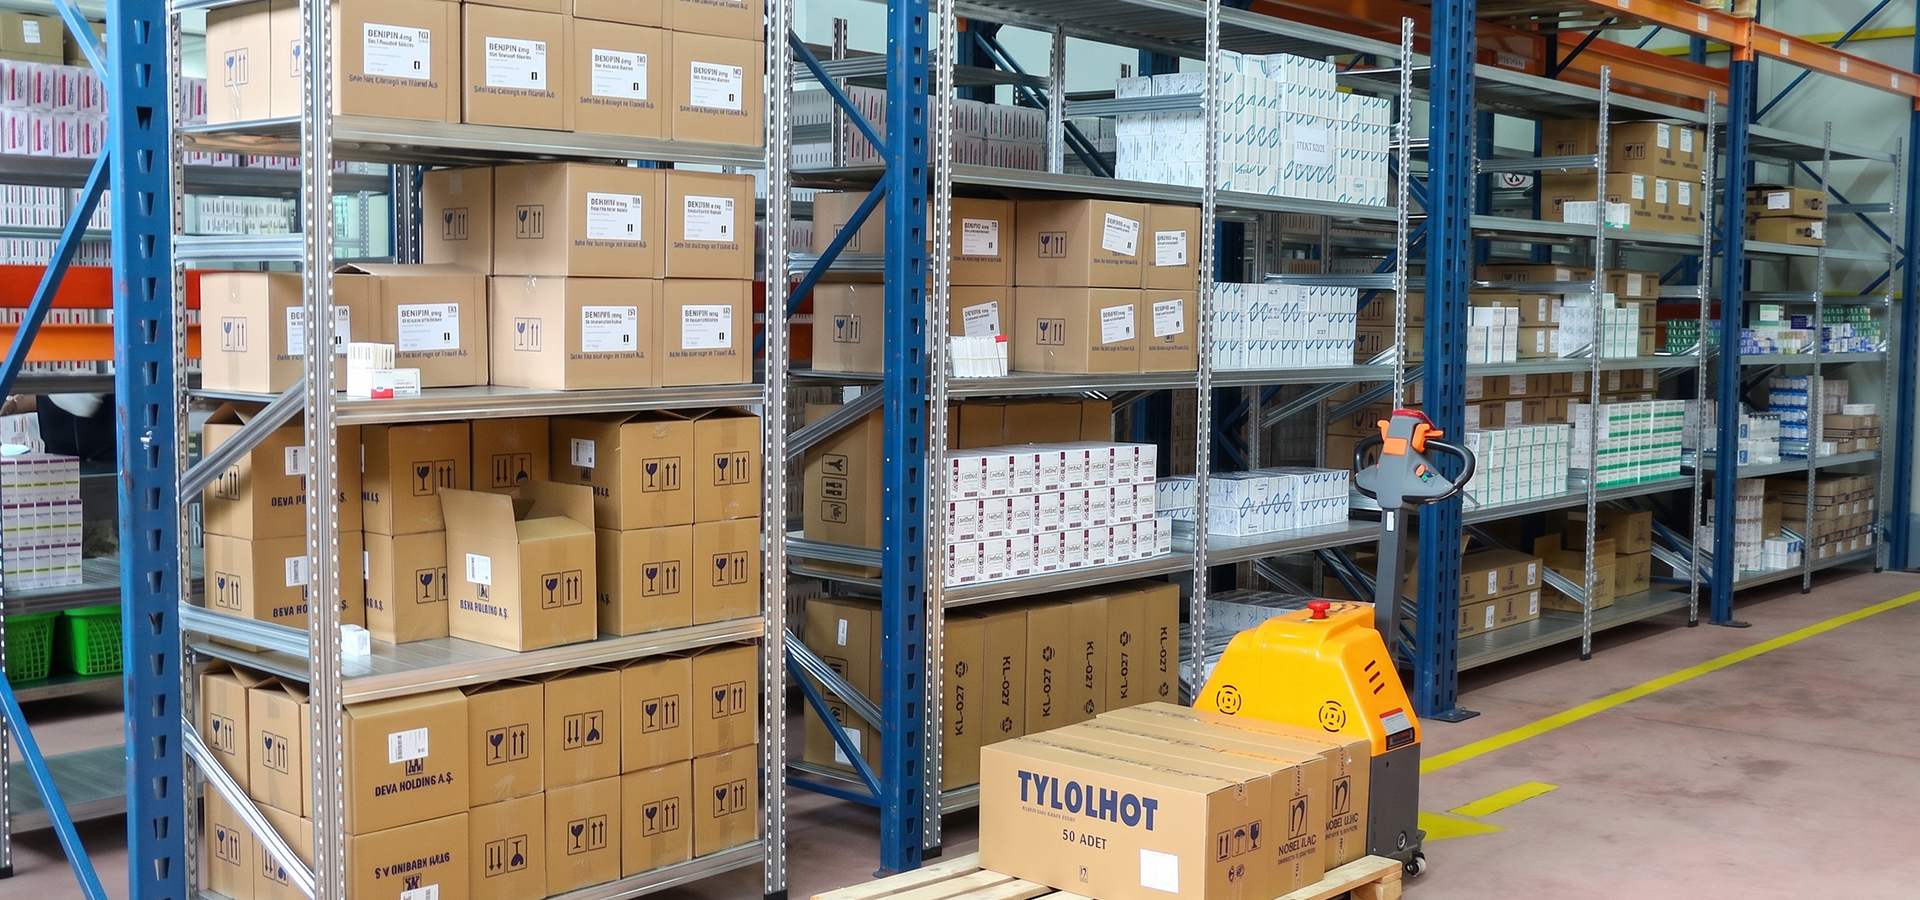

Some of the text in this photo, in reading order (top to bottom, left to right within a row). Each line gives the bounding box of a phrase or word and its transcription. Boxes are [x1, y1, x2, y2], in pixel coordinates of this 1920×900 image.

[1085, 641, 1095, 690] KL-027
[1160, 626, 1168, 674] KL-027
[1001, 656, 1011, 707] KL-027
[1043, 669, 1052, 718] KL-027
[1120, 652, 1129, 699] KL-027
[955, 684, 964, 736] KL-027
[375, 783, 398, 797] DEVA
[1017, 769, 1158, 831] TYLOLHOT
[1062, 828, 1107, 850] 50 ADET
